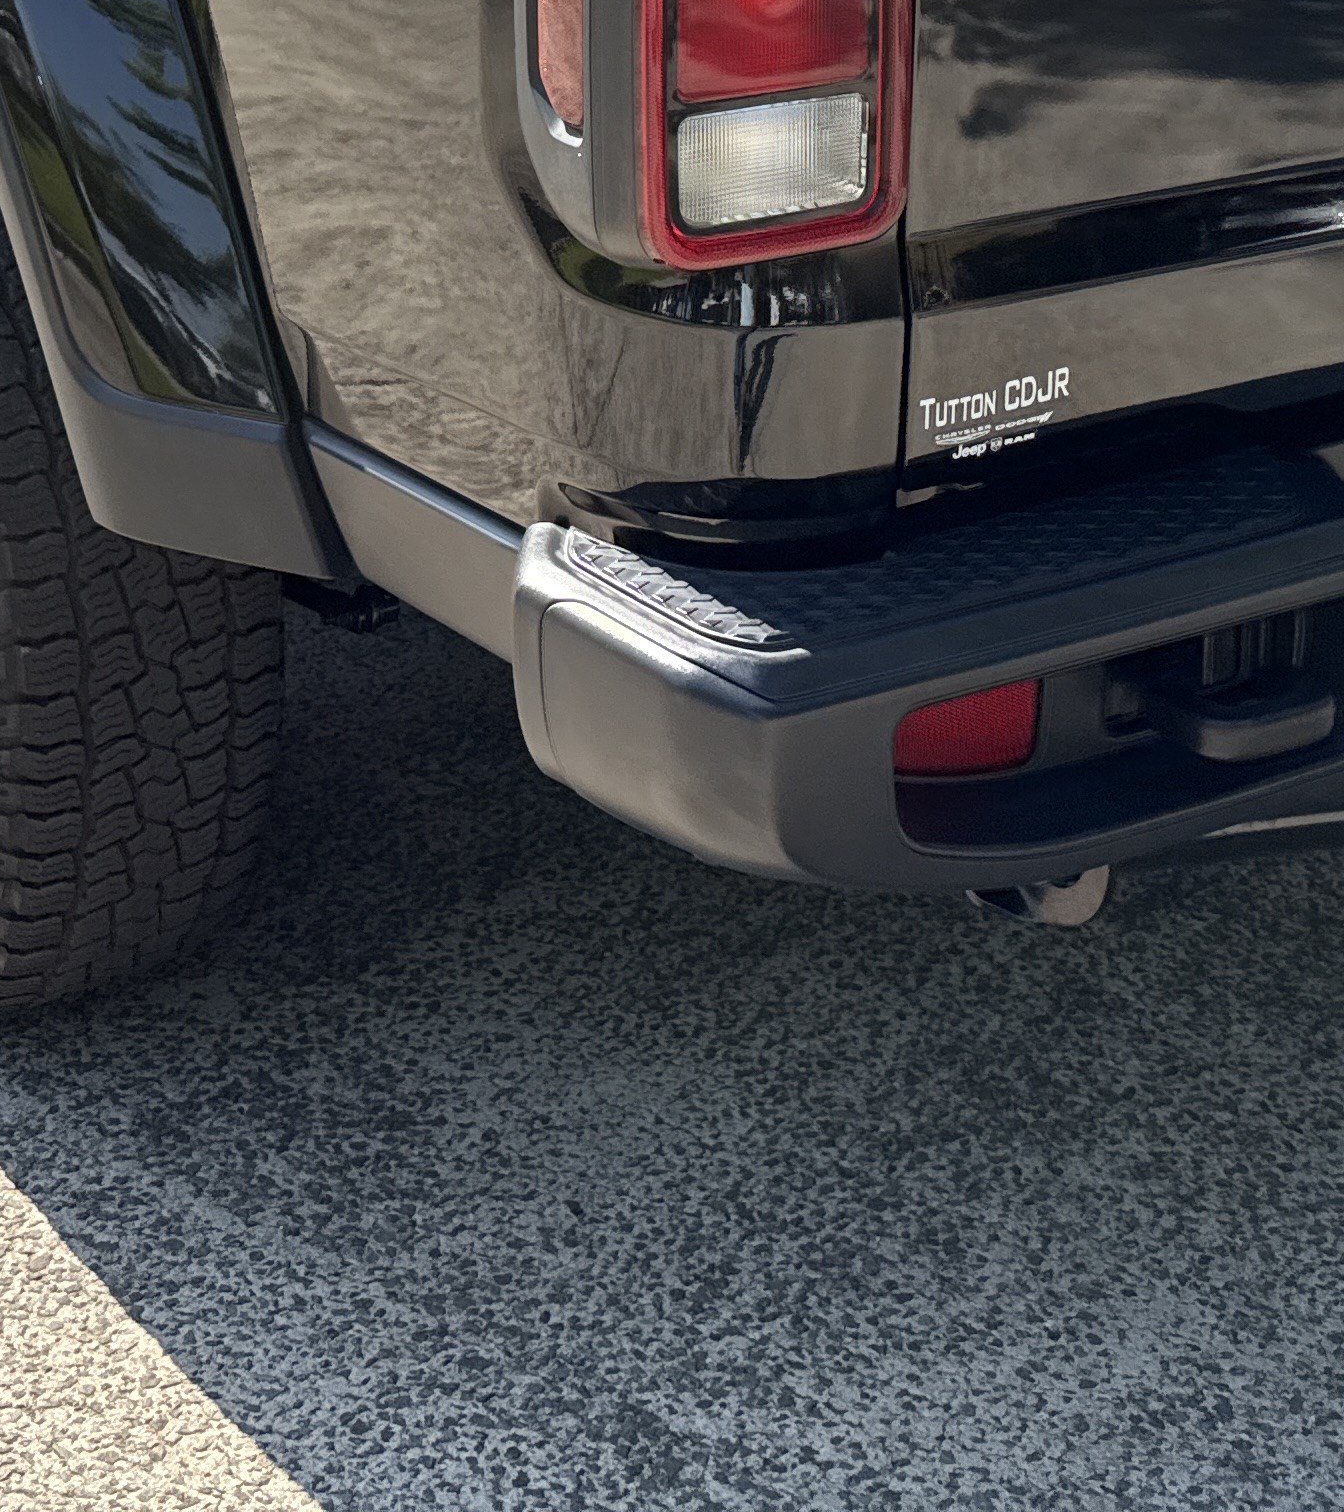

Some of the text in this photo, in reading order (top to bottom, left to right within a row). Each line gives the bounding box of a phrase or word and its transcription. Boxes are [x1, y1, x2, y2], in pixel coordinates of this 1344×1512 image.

[919, 366, 1070, 430] TUTTON CDJR
[935, 424, 992, 441] CHRYSLER
[952, 432, 1036, 461] Jeep RAM
